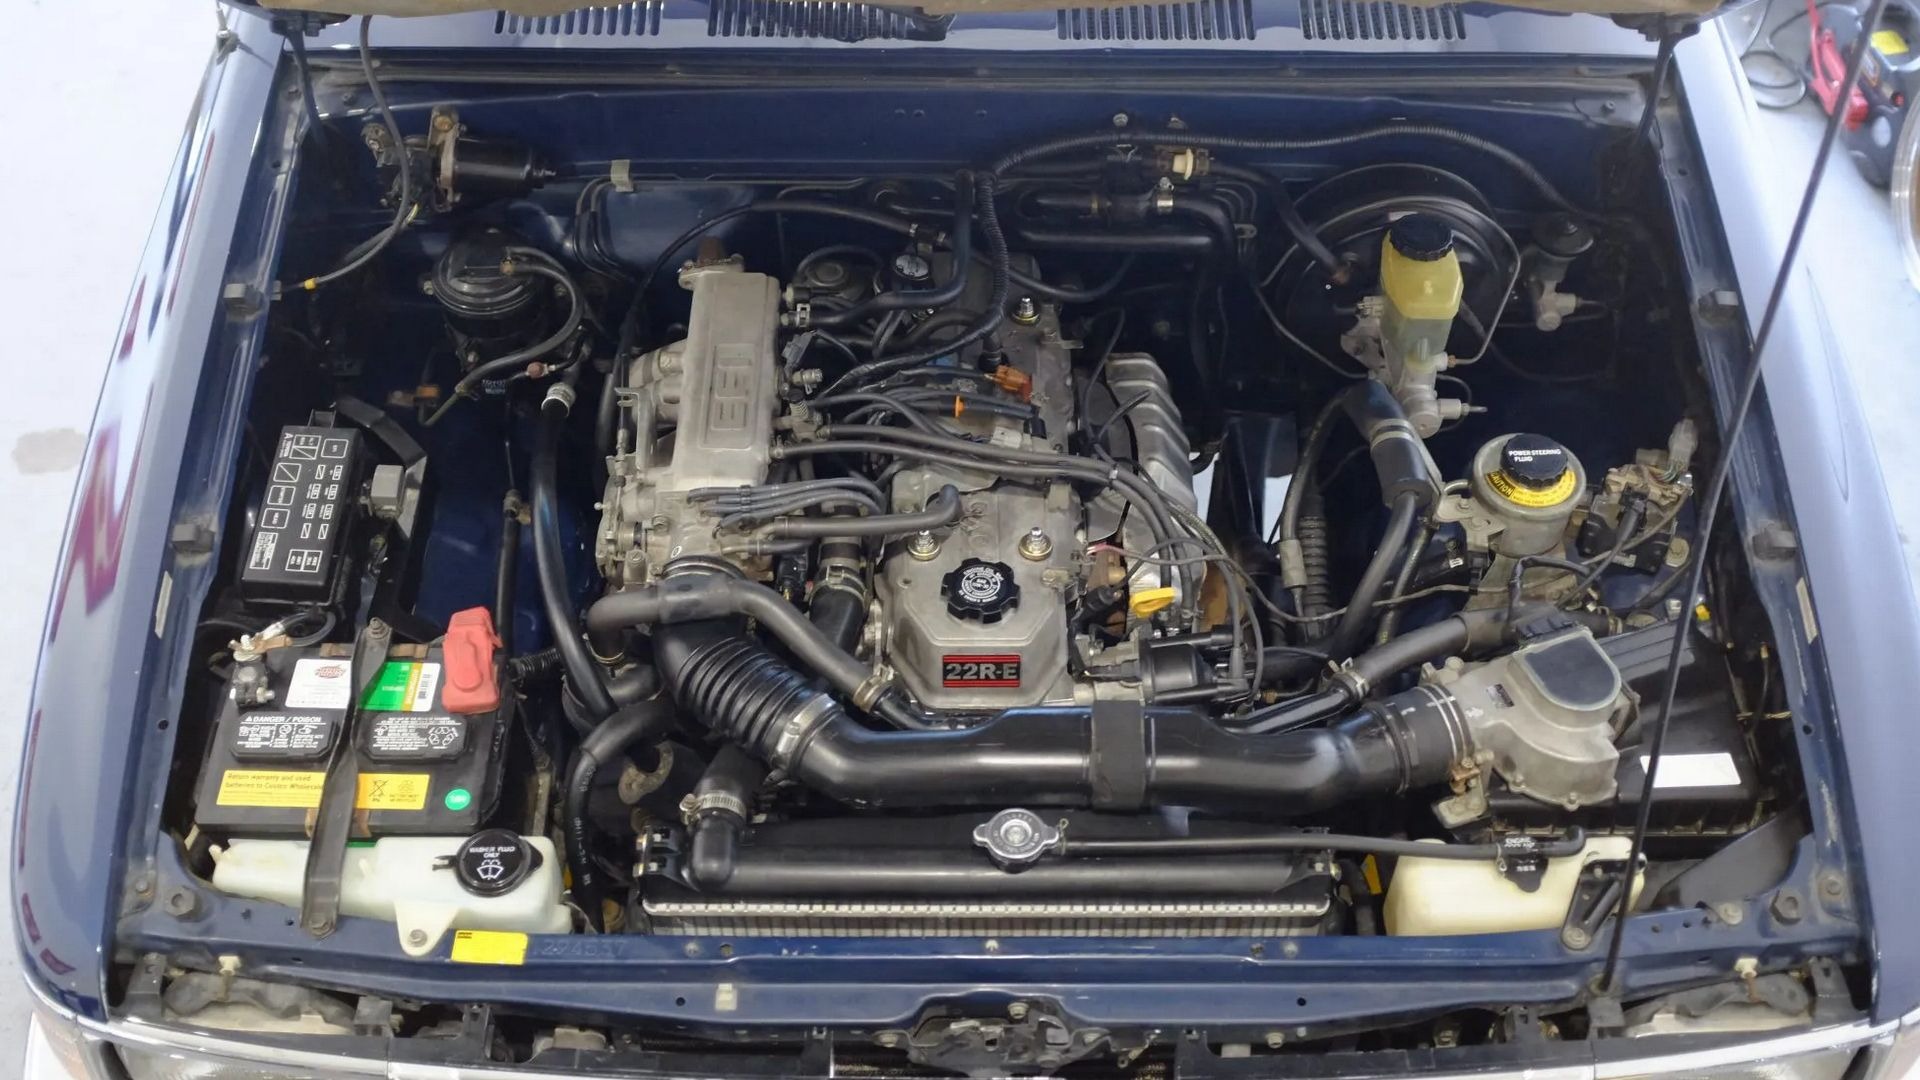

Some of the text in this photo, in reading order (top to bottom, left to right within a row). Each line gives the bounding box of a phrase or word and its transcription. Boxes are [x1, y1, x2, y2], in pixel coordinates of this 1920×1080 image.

[1531, 448, 1561, 456] STEERING
[1490, 470, 1514, 496] CAUTION
[945, 663, 1018, 680] 22R-E
